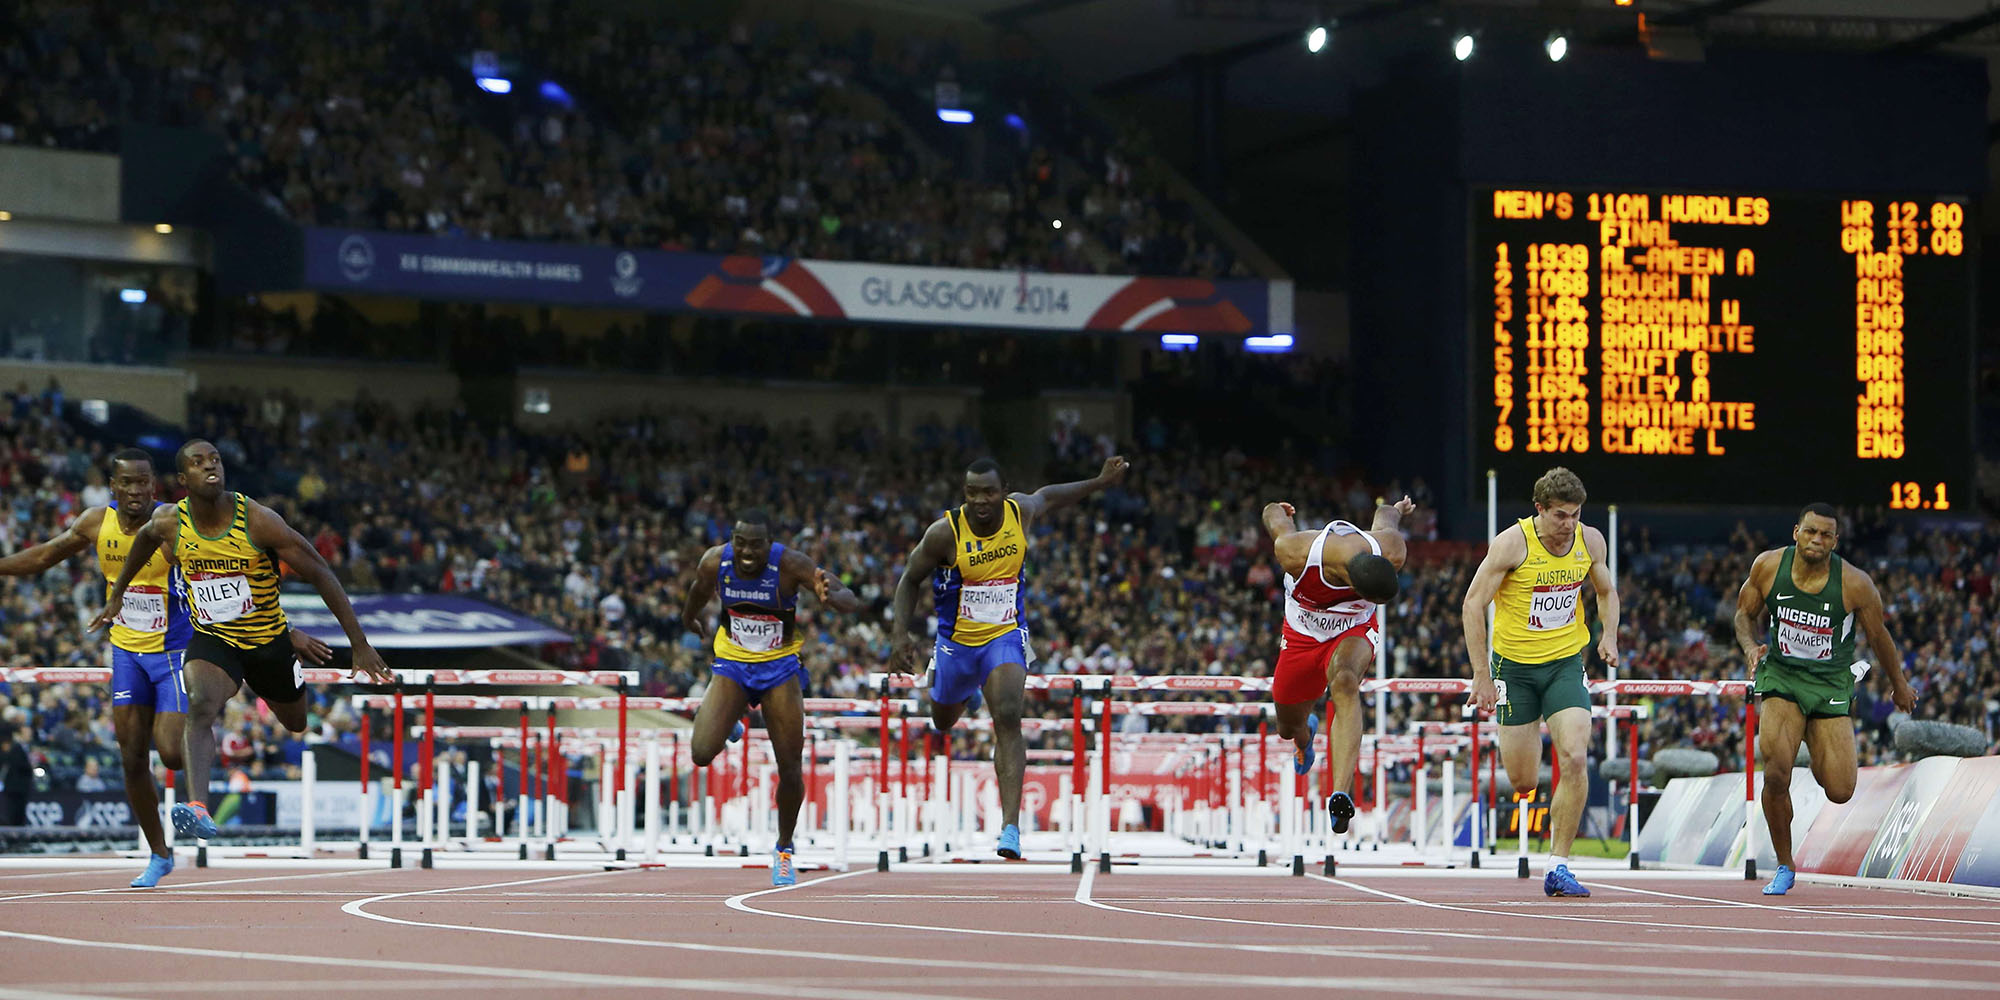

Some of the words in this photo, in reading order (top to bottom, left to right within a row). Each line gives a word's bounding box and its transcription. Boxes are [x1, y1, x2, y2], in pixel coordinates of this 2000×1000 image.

[1494, 190, 1573, 219] MEN'S
[1587, 194, 1649, 221] 110M
[1662, 195, 1769, 225] HURDLES
[1842, 200, 1873, 227] WR
[1887, 202, 1963, 229] 12.80
[1601, 221, 1678, 247] FINAL
[1841, 227, 1873, 253] GR
[1887, 229, 1963, 256] 13.08
[421, 255, 532, 278] COMMONWEALTH
[536, 263, 583, 282] GAMES
[1495, 243, 1511, 270] 1
[1527, 244, 1588, 270] 1939
[1601, 246, 1725, 275] AL-AMEEN
[1737, 249, 1754, 275] A
[860, 276, 1002, 313] GLASGOW
[1014, 281, 1070, 315] 2014
[1495, 270, 1511, 296] 2
[1527, 271, 1588, 297] 1068
[1601, 273, 1678, 299] HOUGH
[1692, 275, 1709, 300] N
[1857, 278, 1903, 304] AUS
[1495, 296, 1512, 322] 3
[1601, 298, 1708, 325] SHARMAN
[1722, 300, 1739, 326] W
[1857, 304, 1903, 329] ENG
[1527, 322, 1588, 349] 1188
[1601, 324, 1754, 353] BRATHWAITE
[1857, 329, 1903, 356] BAR
[1495, 347, 1512, 373] 5
[1527, 348, 1587, 375] 1191
[1601, 350, 1678, 376] SWIFT
[1692, 351, 1709, 377] G
[1857, 355, 1903, 381] BAR
[1495, 373, 1512, 400] 6
[1601, 375, 1679, 402] RILEY
[1692, 377, 1709, 402] A
[1857, 380, 1903, 406] JAM
[1496, 400, 1512, 426] 7
[1527, 401, 1588, 426] 1189
[1601, 402, 1754, 429] BRATHWAITE
[1857, 406, 1903, 432] BAR
[1495, 426, 1513, 452] 8
[1527, 426, 1589, 453] 1378
[1602, 428, 1694, 454] CLARKE
[1708, 429, 1725, 455] L
[1857, 432, 1904, 459] ENG
[1889, 482, 1949, 510] 13.1
[188, 559, 249, 571] JAMAICA
[969, 544, 1018, 567] BARBADOS
[1536, 569, 1583, 585] AUSTRALIA
[197, 581, 242, 603] RILEY
[725, 587, 771, 600] Barbados
[964, 588, 1014, 604] BRATHWAITE
[733, 618, 779, 636] SWIFT
[1777, 606, 1831, 628] NIGERIA
[1780, 627, 1830, 647] AL-AMEEN
[1174, 677, 1214, 688] GLASGOW
[1397, 681, 1437, 690] GLASGOW
[1624, 683, 1665, 693] GLASGOW
[1667, 684, 1685, 693] 2014
[26, 803, 63, 825] sse
